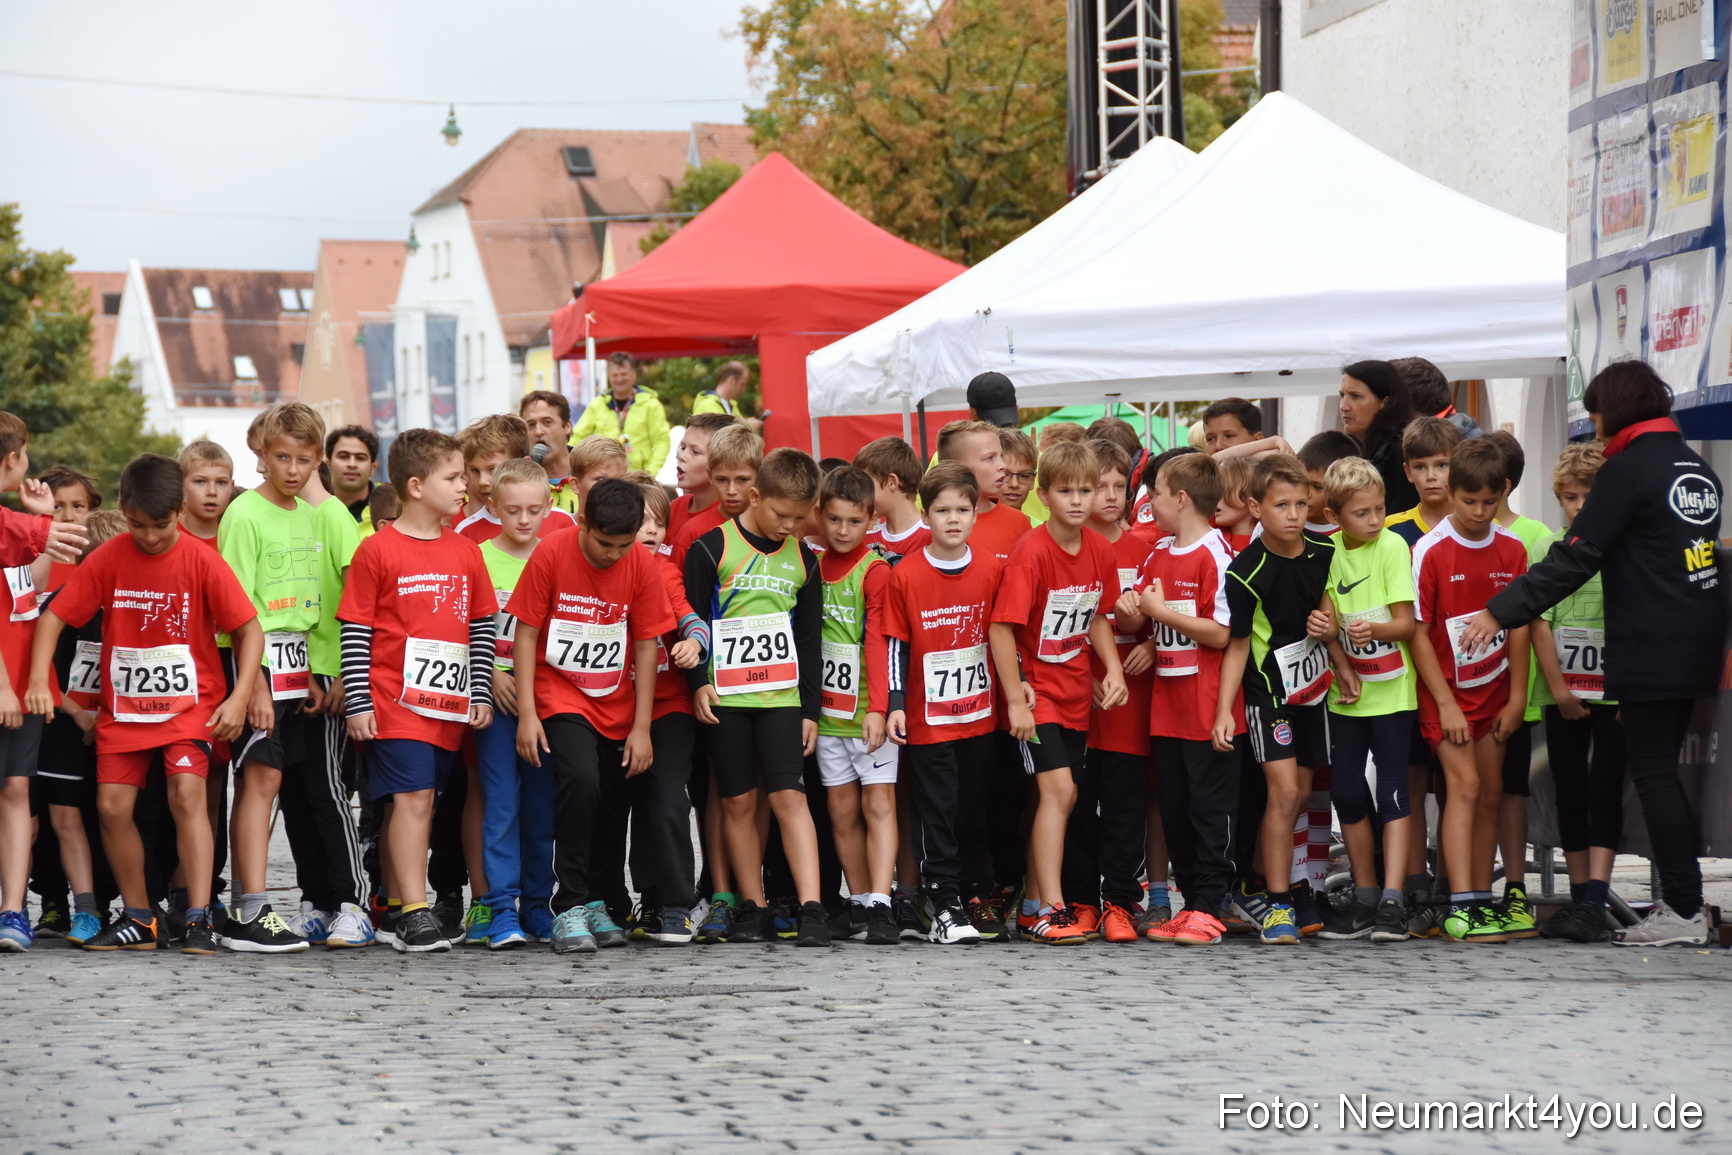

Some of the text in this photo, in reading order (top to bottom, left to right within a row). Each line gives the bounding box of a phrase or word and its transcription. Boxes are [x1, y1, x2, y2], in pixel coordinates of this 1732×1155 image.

[1656, 0, 1698, 26] RAIL.ONE
[1676, 486, 1716, 513] Hervis
[398, 573, 449, 584] Neumarkter
[398, 583, 440, 596] Stadtlauf
[733, 574, 794, 597] BOCK
[181, 592, 189, 638] BAMBINI
[749, 616, 784, 628] BOCK
[921, 605, 970, 619] Neumarkter
[1052, 602, 1095, 635] 711
[272, 641, 307, 669] 706
[557, 640, 620, 669] 7422
[722, 632, 789, 665] 7239
[119, 663, 189, 693] 7235
[414, 657, 468, 693] 7230
[746, 669, 768, 682] Joel
[822, 660, 851, 690] 28
[1288, 643, 1326, 688] 7077
[934, 662, 987, 698] 7179
[140, 700, 170, 711] Lukas
[418, 693, 460, 710] Ben Leon
[952, 701, 977, 714] Quirin
